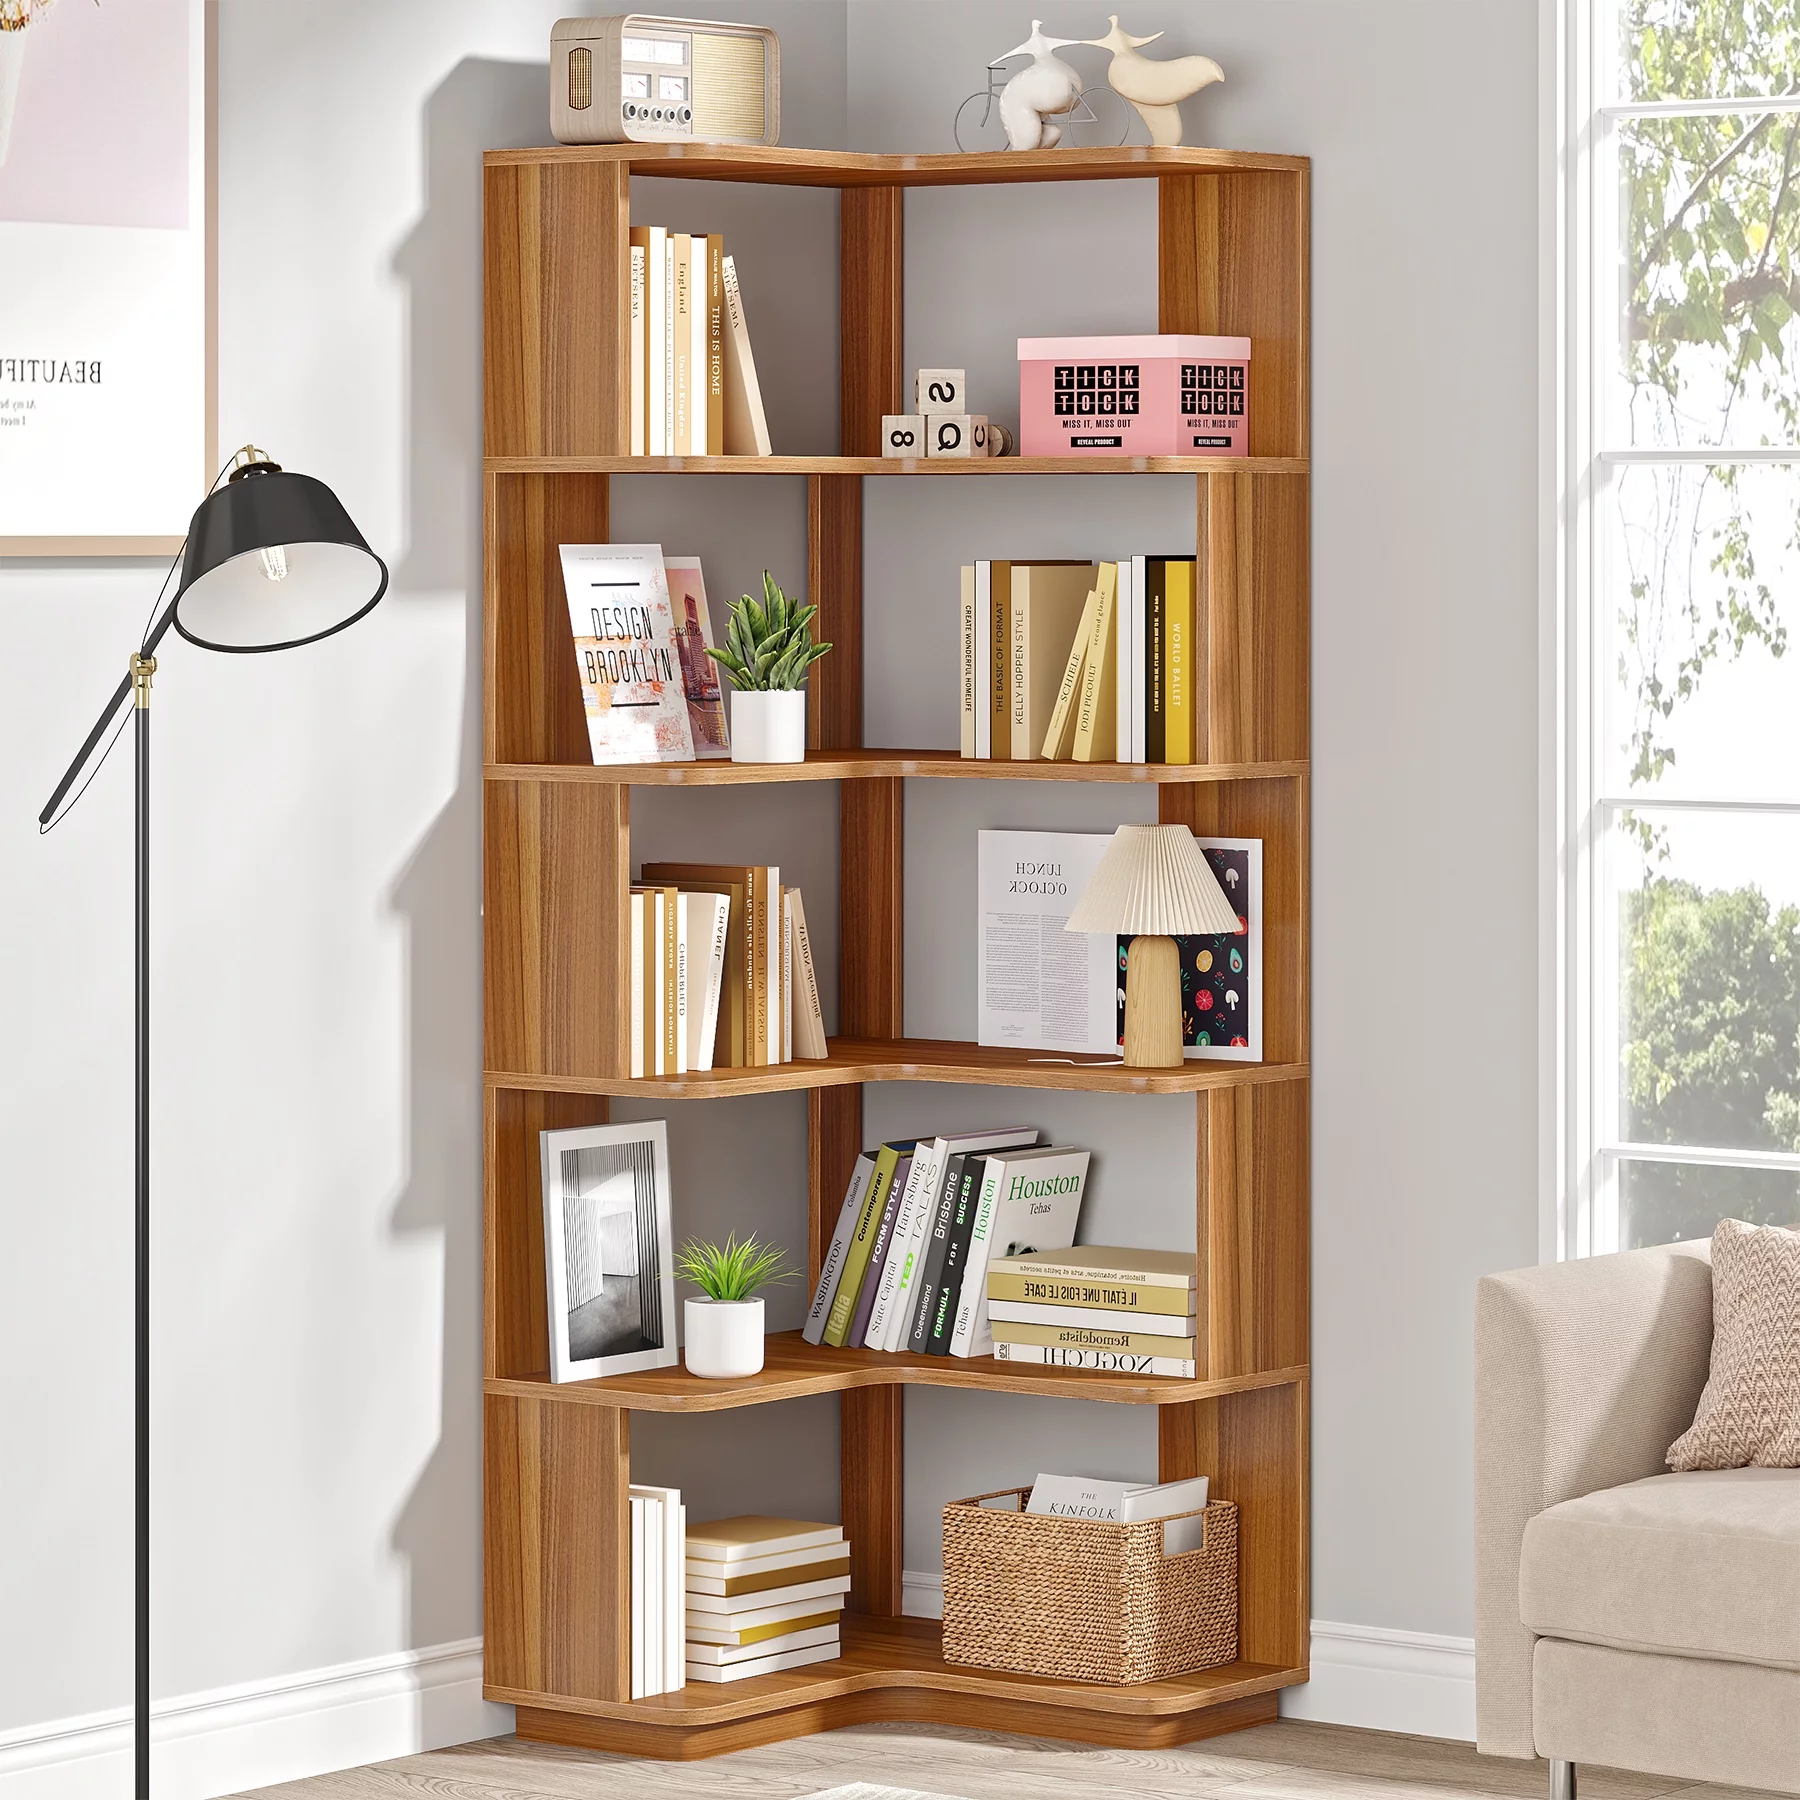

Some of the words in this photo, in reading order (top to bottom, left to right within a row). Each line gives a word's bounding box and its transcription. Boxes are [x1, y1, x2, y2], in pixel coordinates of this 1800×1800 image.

[678, 262, 687, 314] England
[724, 266, 739, 329] SIETSEMA
[729, 265, 739, 298] PAUL
[712, 306, 720, 336] THIS
[712, 340, 720, 352] IS
[712, 355, 720, 396] HOME
[1060, 369, 1134, 387] TICK
[1185, 369, 1240, 387] TICK
[678, 392, 686, 437] Kingdom
[1060, 394, 1134, 412] TOCK
[1185, 394, 1240, 412] TOCK
[1062, 420, 1081, 428] MISS
[1084, 420, 1092, 430] IT,
[1096, 419, 1114, 428] MISS
[1187, 418, 1202, 428] MISS
[1212, 420, 1226, 428] MISS
[591, 606, 654, 641] DESIGN
[1016, 609, 1024, 642] STYLE
[996, 646, 1004, 661] OF
[1172, 623, 1180, 663] WORLD
[585, 648, 673, 684] BROOKLYN
[1016, 645, 1024, 686] HOPPEN
[1061, 653, 1080, 702] SCHIELE
[1084, 663, 1096, 706] PICOULT
[1172, 667, 1180, 706] BALLET
[1016, 693, 1024, 724] KELLY
[1080, 707, 1090, 732] JODI
[1008, 1174, 1080, 1202] Houston
[872, 1224, 888, 1264] FORM
[884, 1178, 901, 1220] STYLE
[974, 1178, 996, 1242] Houston
[1029, 1202, 1052, 1215] Tehas
[811, 1239, 842, 1318] WASHINGTON
[847, 1176, 862, 1208] Columbia
[826, 1294, 850, 1335] Italia
[858, 1172, 883, 1242] Contemporan
[872, 1302, 886, 1334] State
[881, 1260, 897, 1301] Capital
[896, 1159, 926, 1238] Harrisburg
[914, 1284, 932, 1339] Queensland
[934, 1172, 958, 1239] Brisbane
[934, 1286, 950, 1339] FORMULA
[948, 1242, 958, 1266] FOR
[956, 1174, 972, 1225] SUCCESS
[900, 1252, 914, 1290] TED
[1049, 1502, 1116, 1520] KINFOLK
